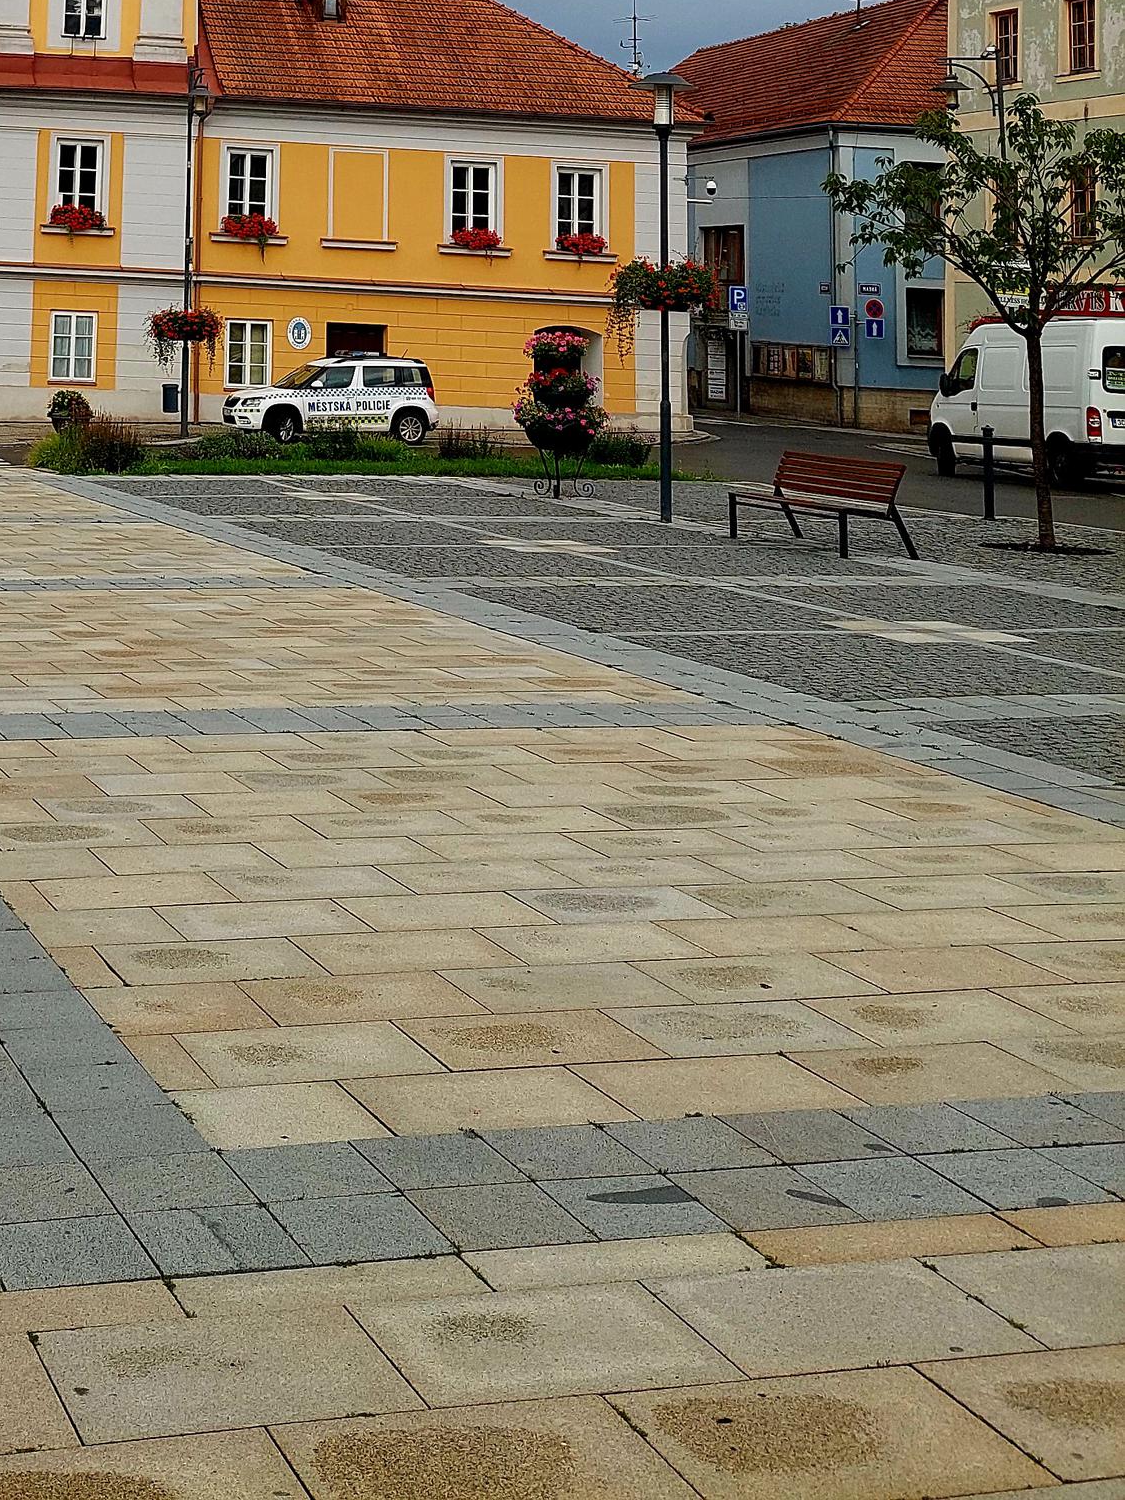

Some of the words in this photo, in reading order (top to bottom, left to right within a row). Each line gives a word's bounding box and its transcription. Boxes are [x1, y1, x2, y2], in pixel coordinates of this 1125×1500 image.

[734, 289, 744, 304] P
[308, 398, 352, 412] MĚSTSKÁ
[356, 399, 392, 411] POLICIE
